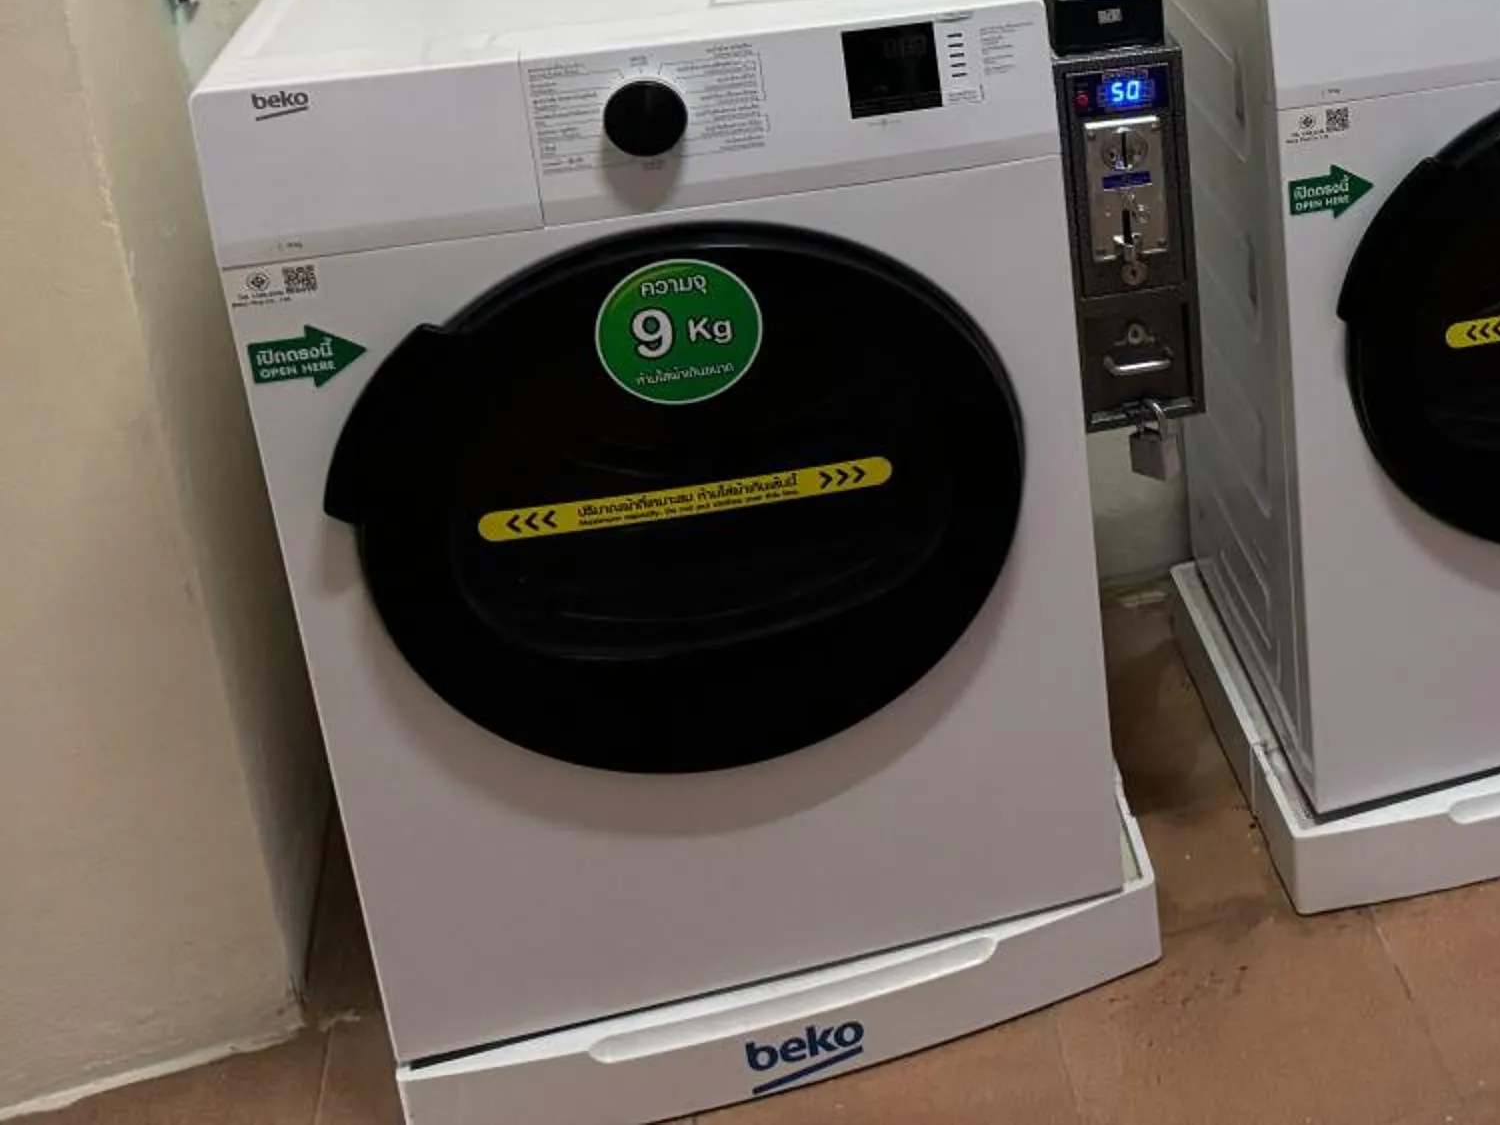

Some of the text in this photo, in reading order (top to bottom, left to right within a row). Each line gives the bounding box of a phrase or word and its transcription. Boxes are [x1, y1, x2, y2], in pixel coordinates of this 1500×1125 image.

[252, 89, 309, 111] beko
[1111, 80, 1139, 102] 50
[641, 275, 707, 297] ความจุ
[632, 309, 732, 358] 9 Kg
[260, 360, 337, 379] OPEN HERE
[745, 1020, 864, 1071] beko
